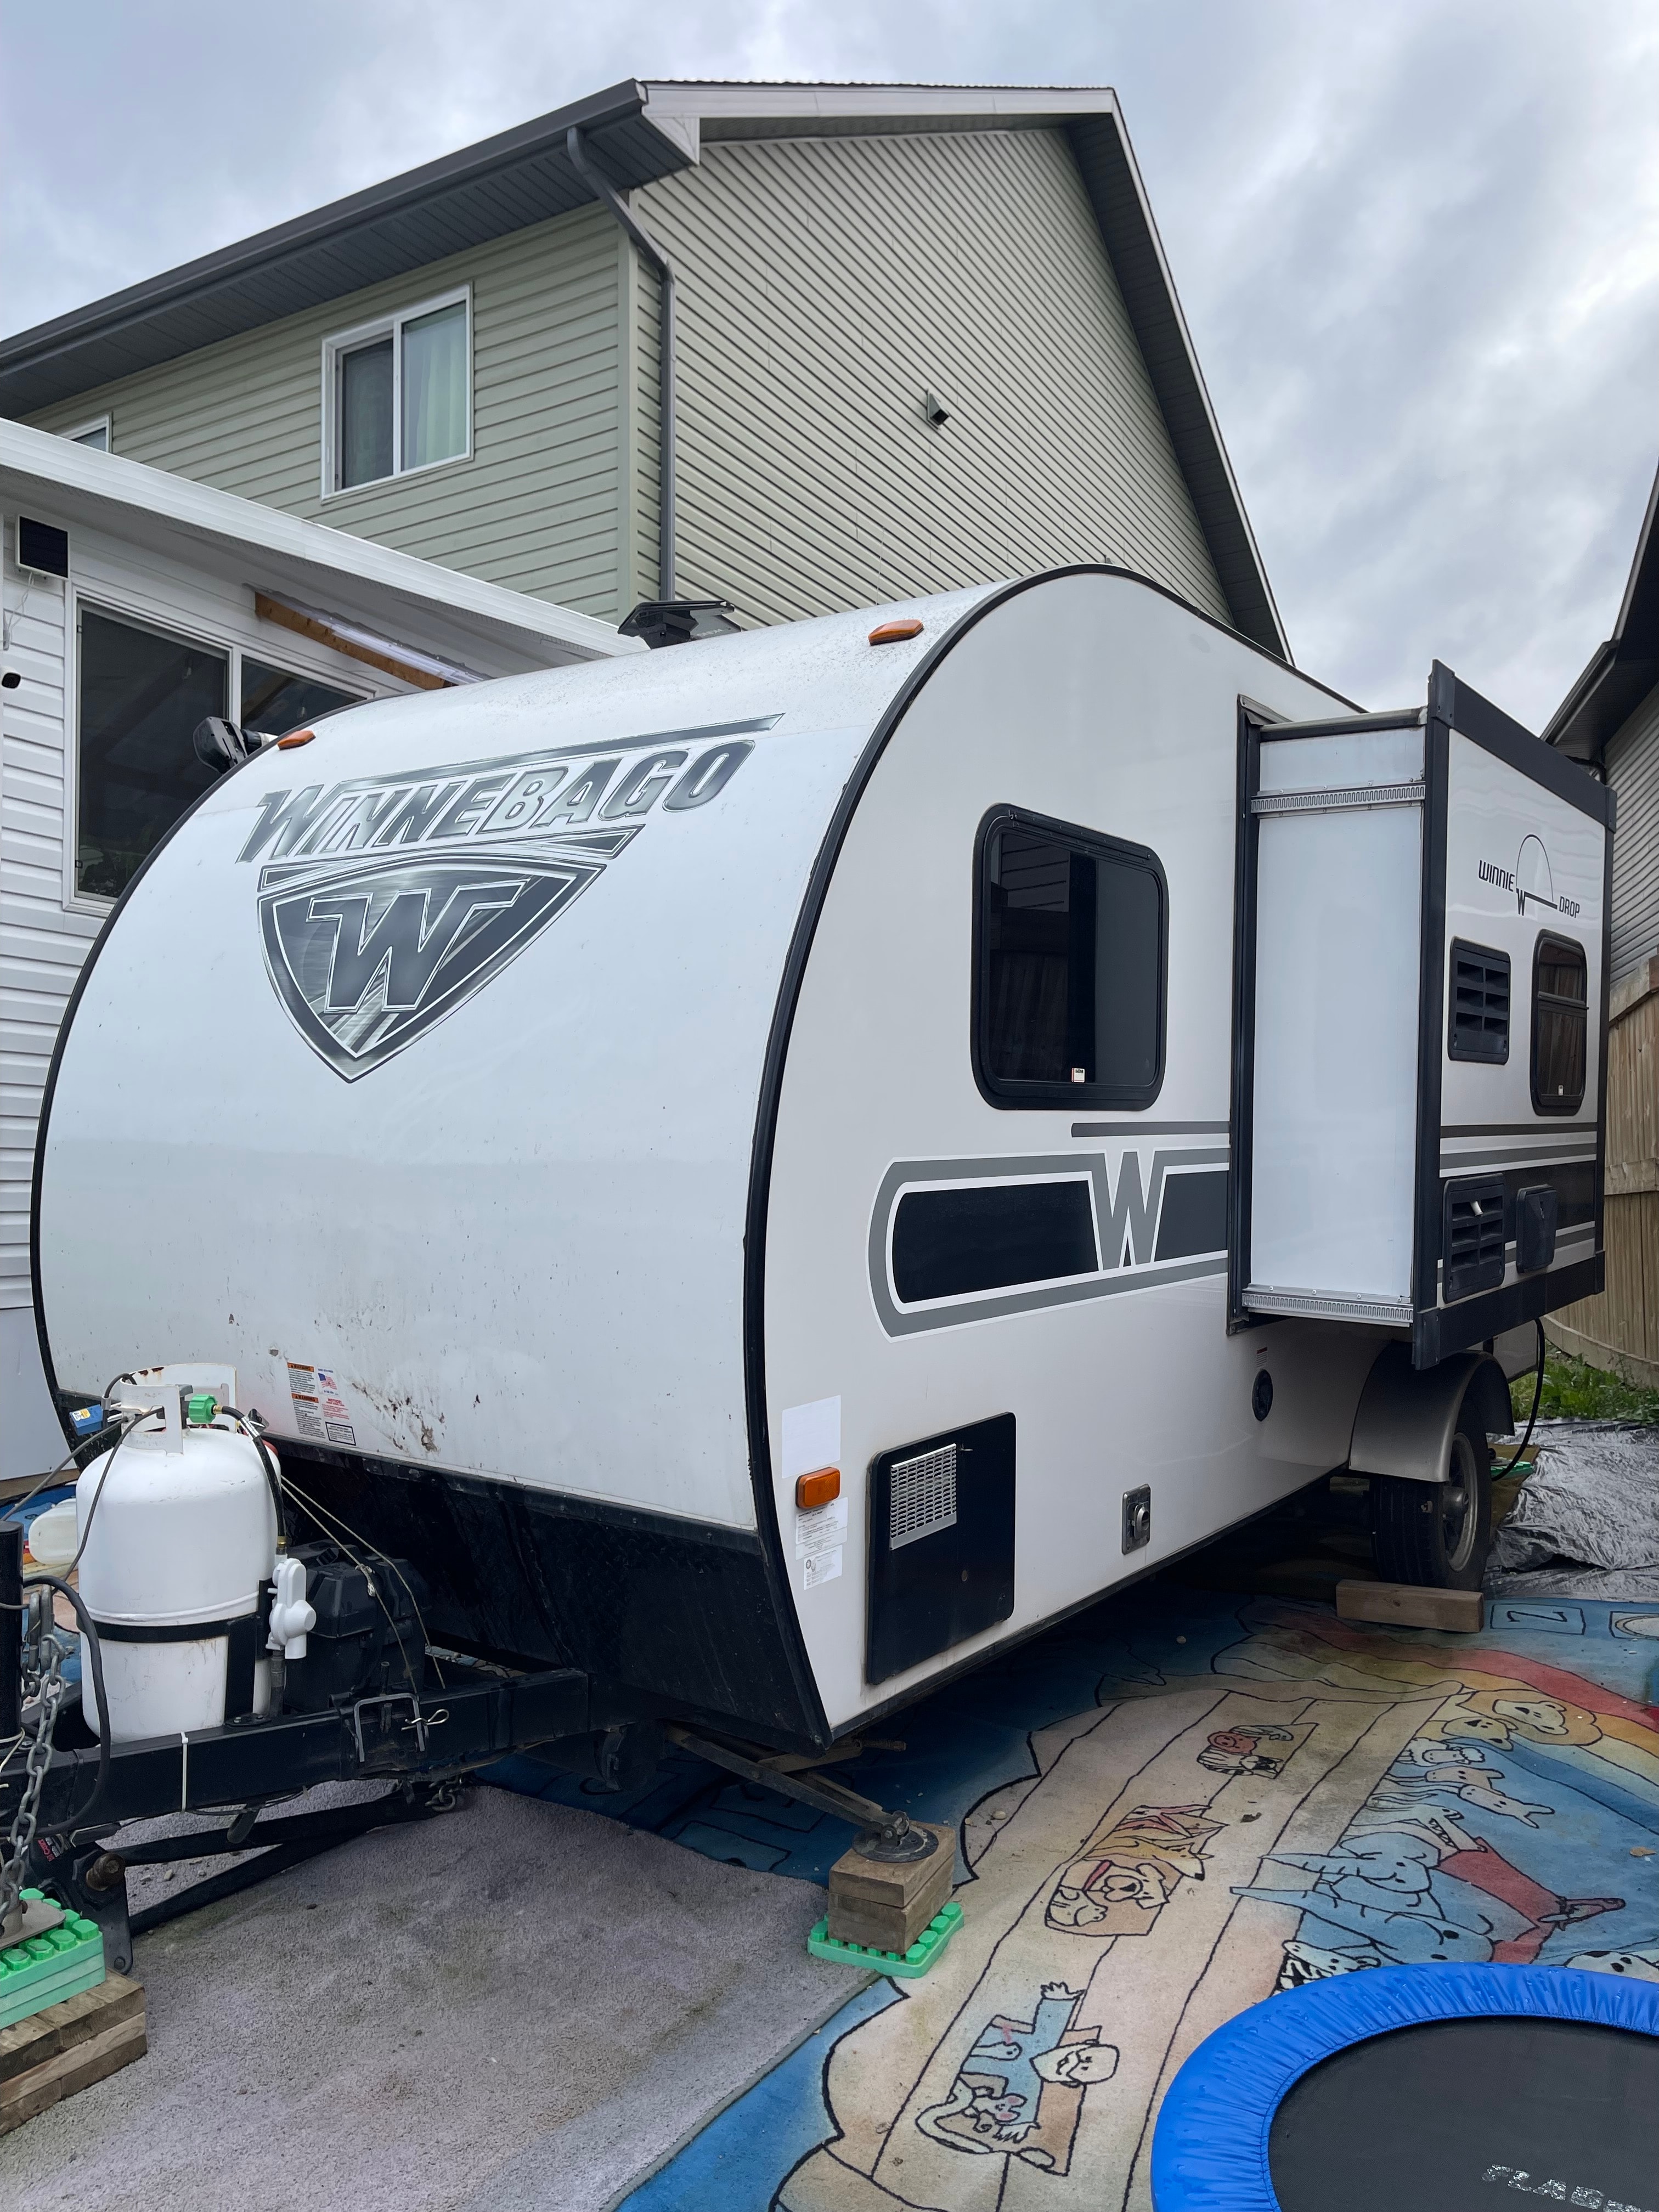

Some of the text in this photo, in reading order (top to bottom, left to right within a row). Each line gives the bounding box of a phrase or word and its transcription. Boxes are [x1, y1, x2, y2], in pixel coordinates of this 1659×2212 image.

[235, 740, 756, 864] WINNEBAGO
[306, 878, 531, 1014] W
[1479, 860, 1580, 918] WINNIE DROP
